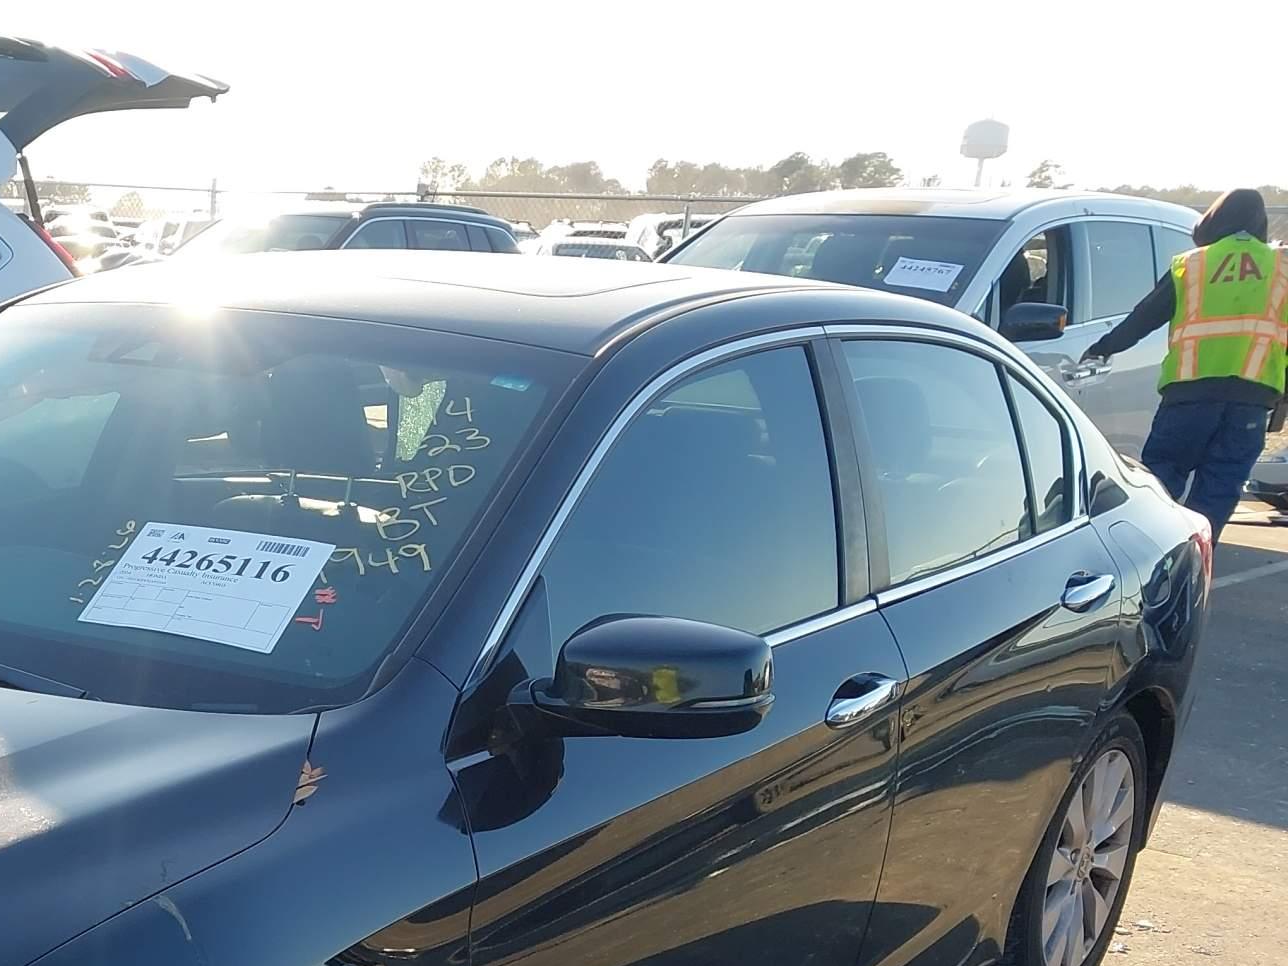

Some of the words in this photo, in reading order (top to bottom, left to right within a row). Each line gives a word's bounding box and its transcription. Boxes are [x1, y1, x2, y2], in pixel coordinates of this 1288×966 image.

[396, 464, 476, 498] RPD
[122, 562, 166, 574] Progressive
[167, 568, 199, 579] Casualty
[201, 572, 240, 583] Insurance
[140, 546, 297, 583] 44265116
